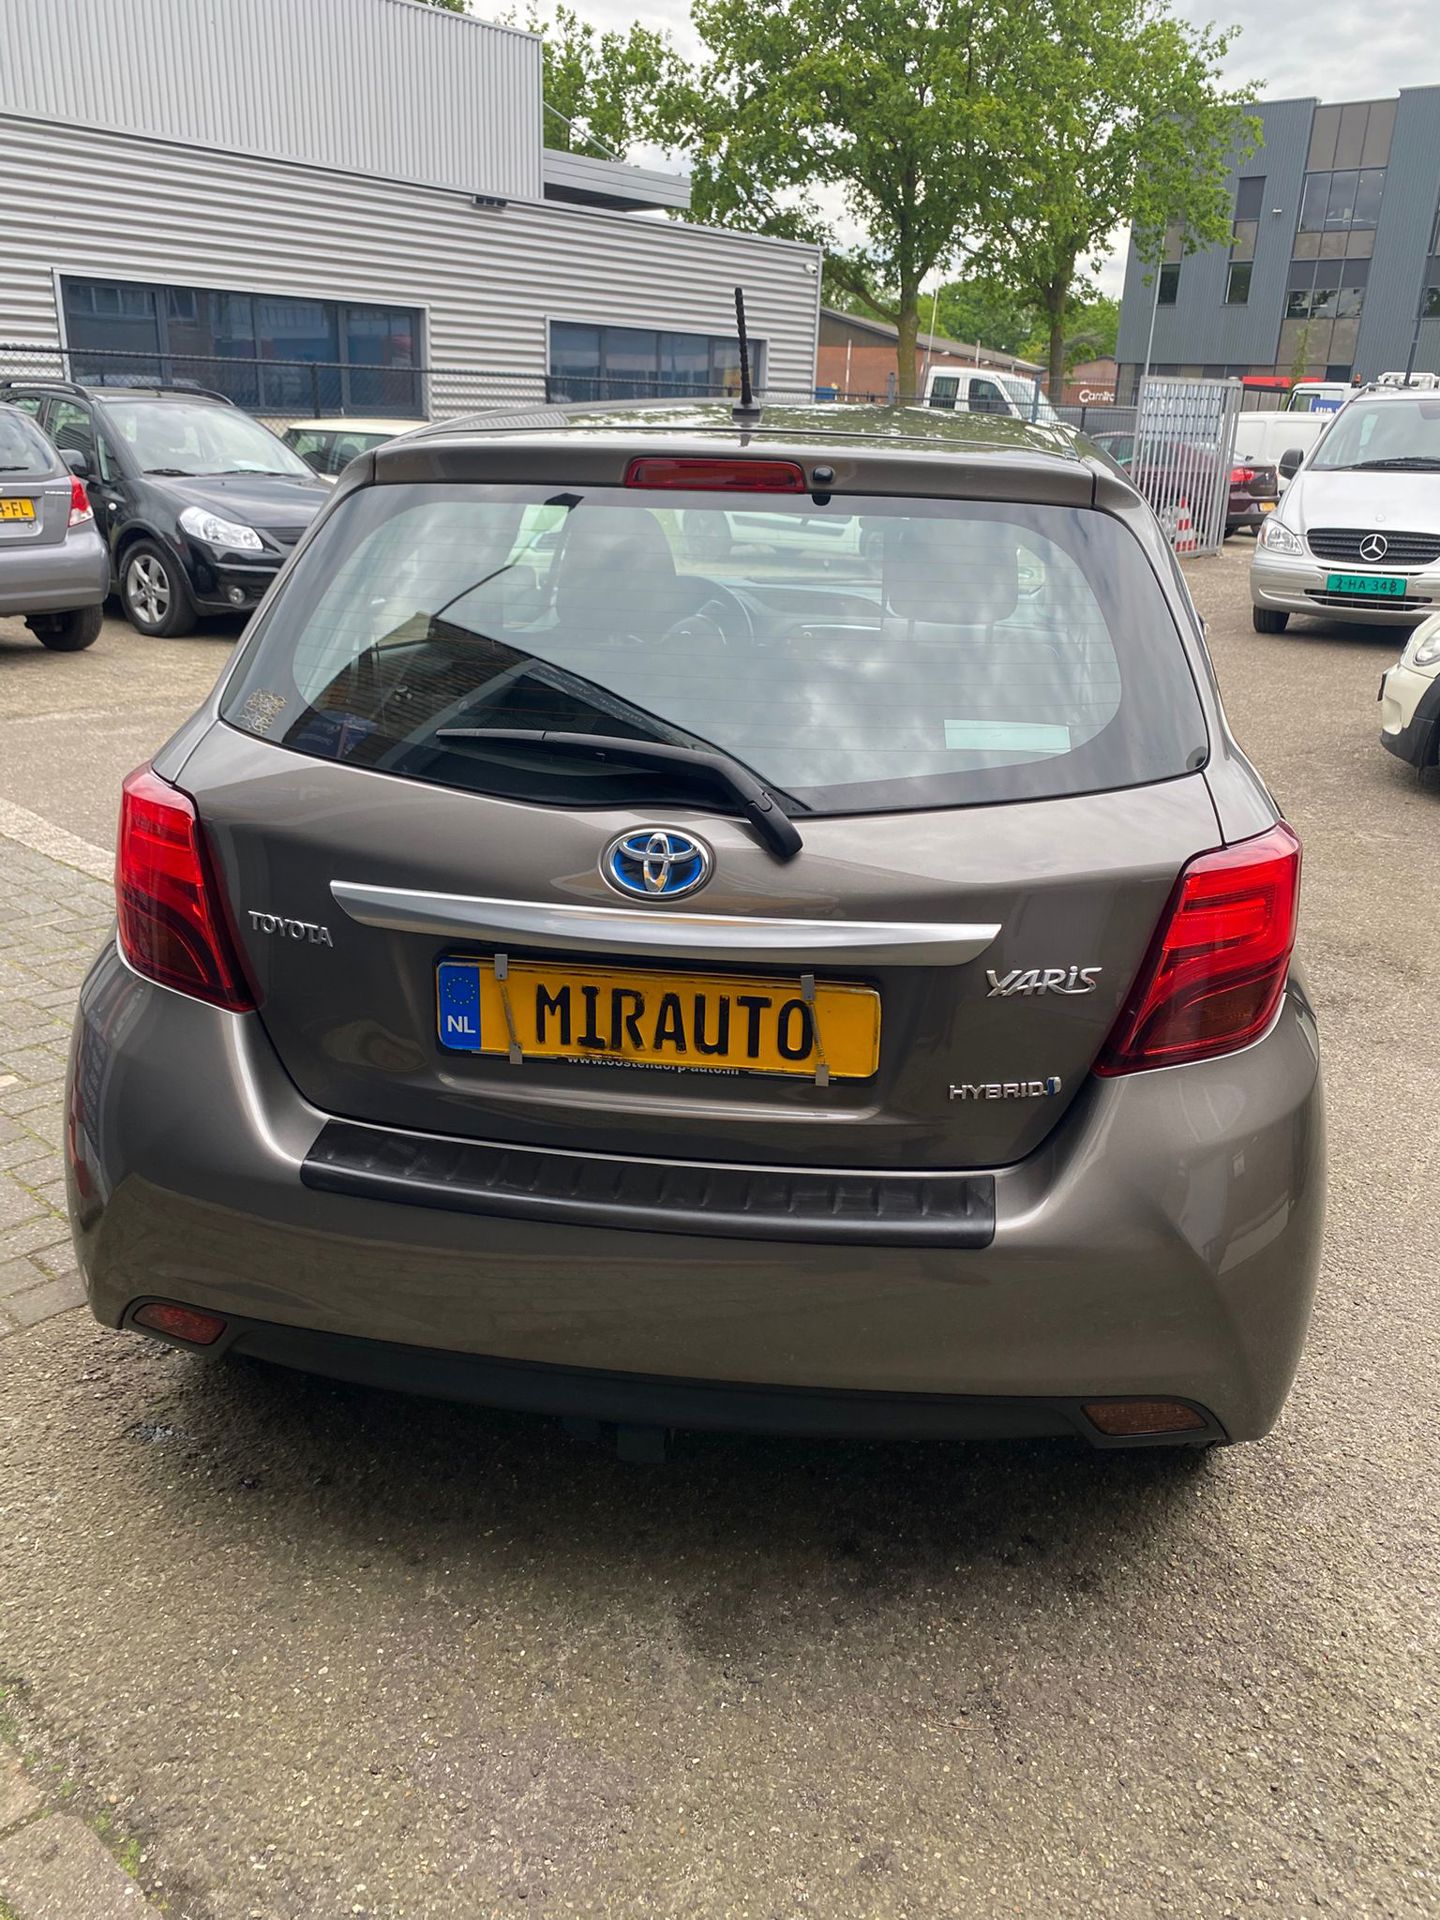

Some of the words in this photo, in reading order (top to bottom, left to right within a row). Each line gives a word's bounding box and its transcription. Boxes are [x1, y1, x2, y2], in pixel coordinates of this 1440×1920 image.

[248, 910, 334, 948] TOYOTA
[447, 1015, 477, 1034] NL
[536, 983, 813, 1060] MIRAUTO
[949, 1081, 1044, 1100] HYBRID
